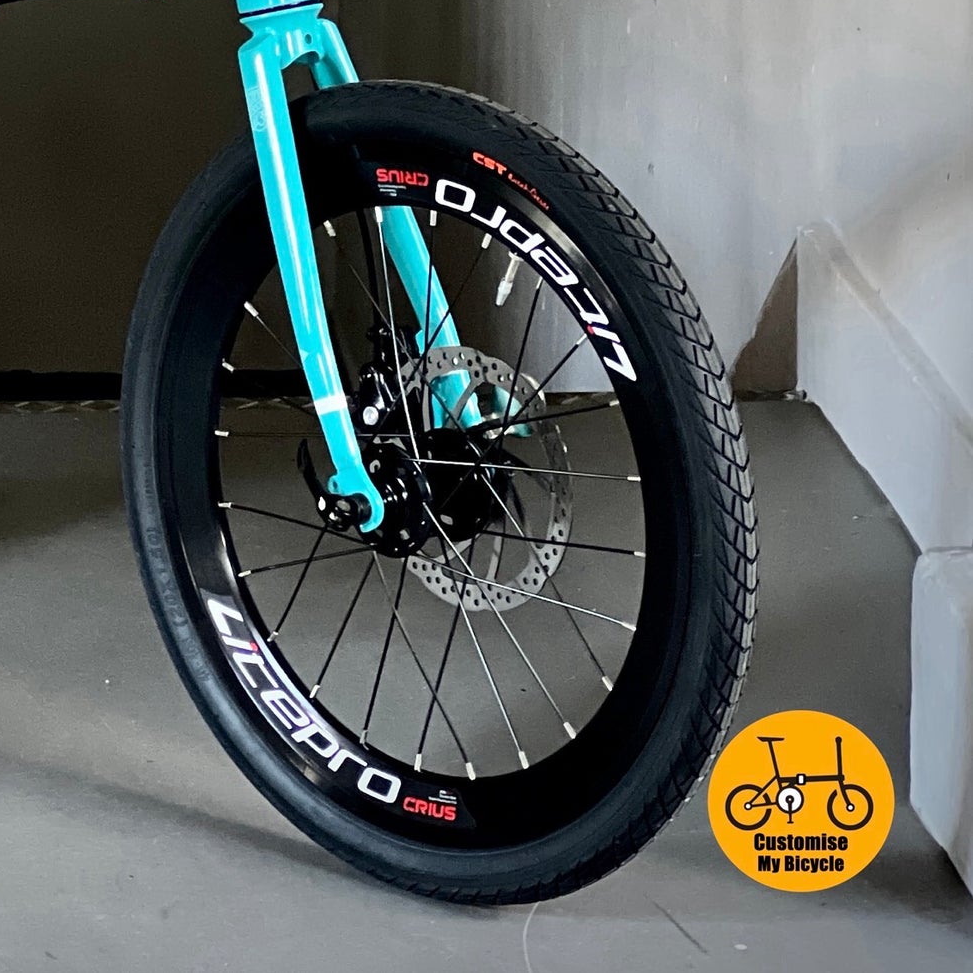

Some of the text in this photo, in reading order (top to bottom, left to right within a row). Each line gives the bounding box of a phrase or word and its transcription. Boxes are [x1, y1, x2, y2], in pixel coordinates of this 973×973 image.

[472, 151, 507, 176] CST
[376, 168, 429, 187] CRIUS
[402, 796, 457, 821] CRIUS
